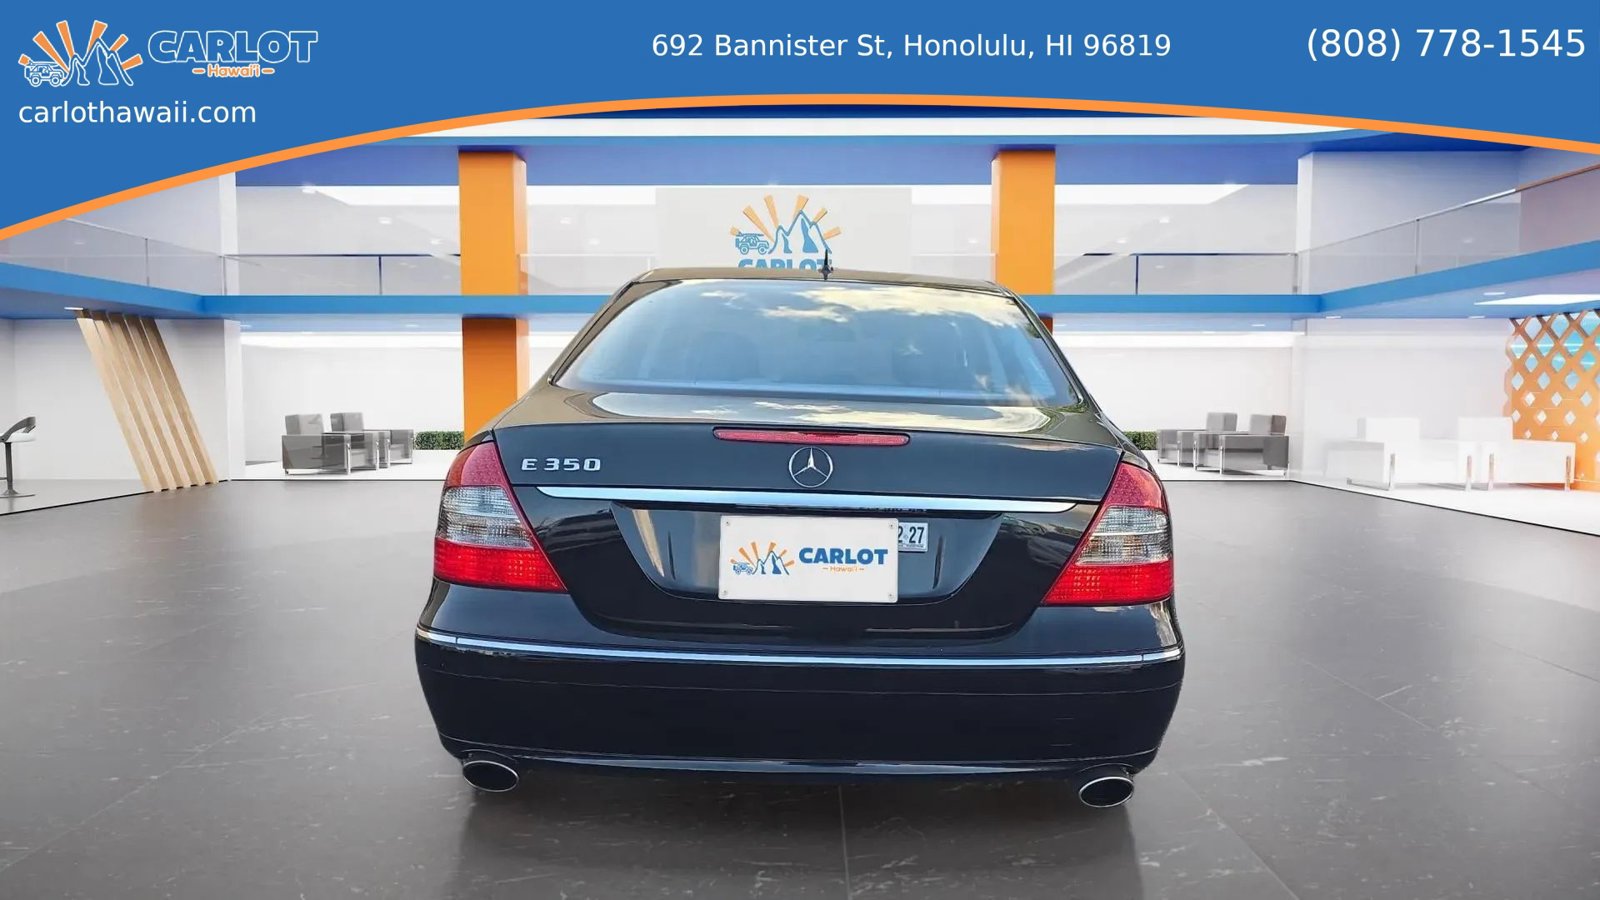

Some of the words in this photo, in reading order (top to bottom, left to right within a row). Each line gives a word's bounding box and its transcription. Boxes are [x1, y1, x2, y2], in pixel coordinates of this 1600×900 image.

[521, 458, 537, 471] E
[544, 458, 601, 471] 350
[908, 526, 925, 543] 27
[799, 547, 889, 565] CARLOT
